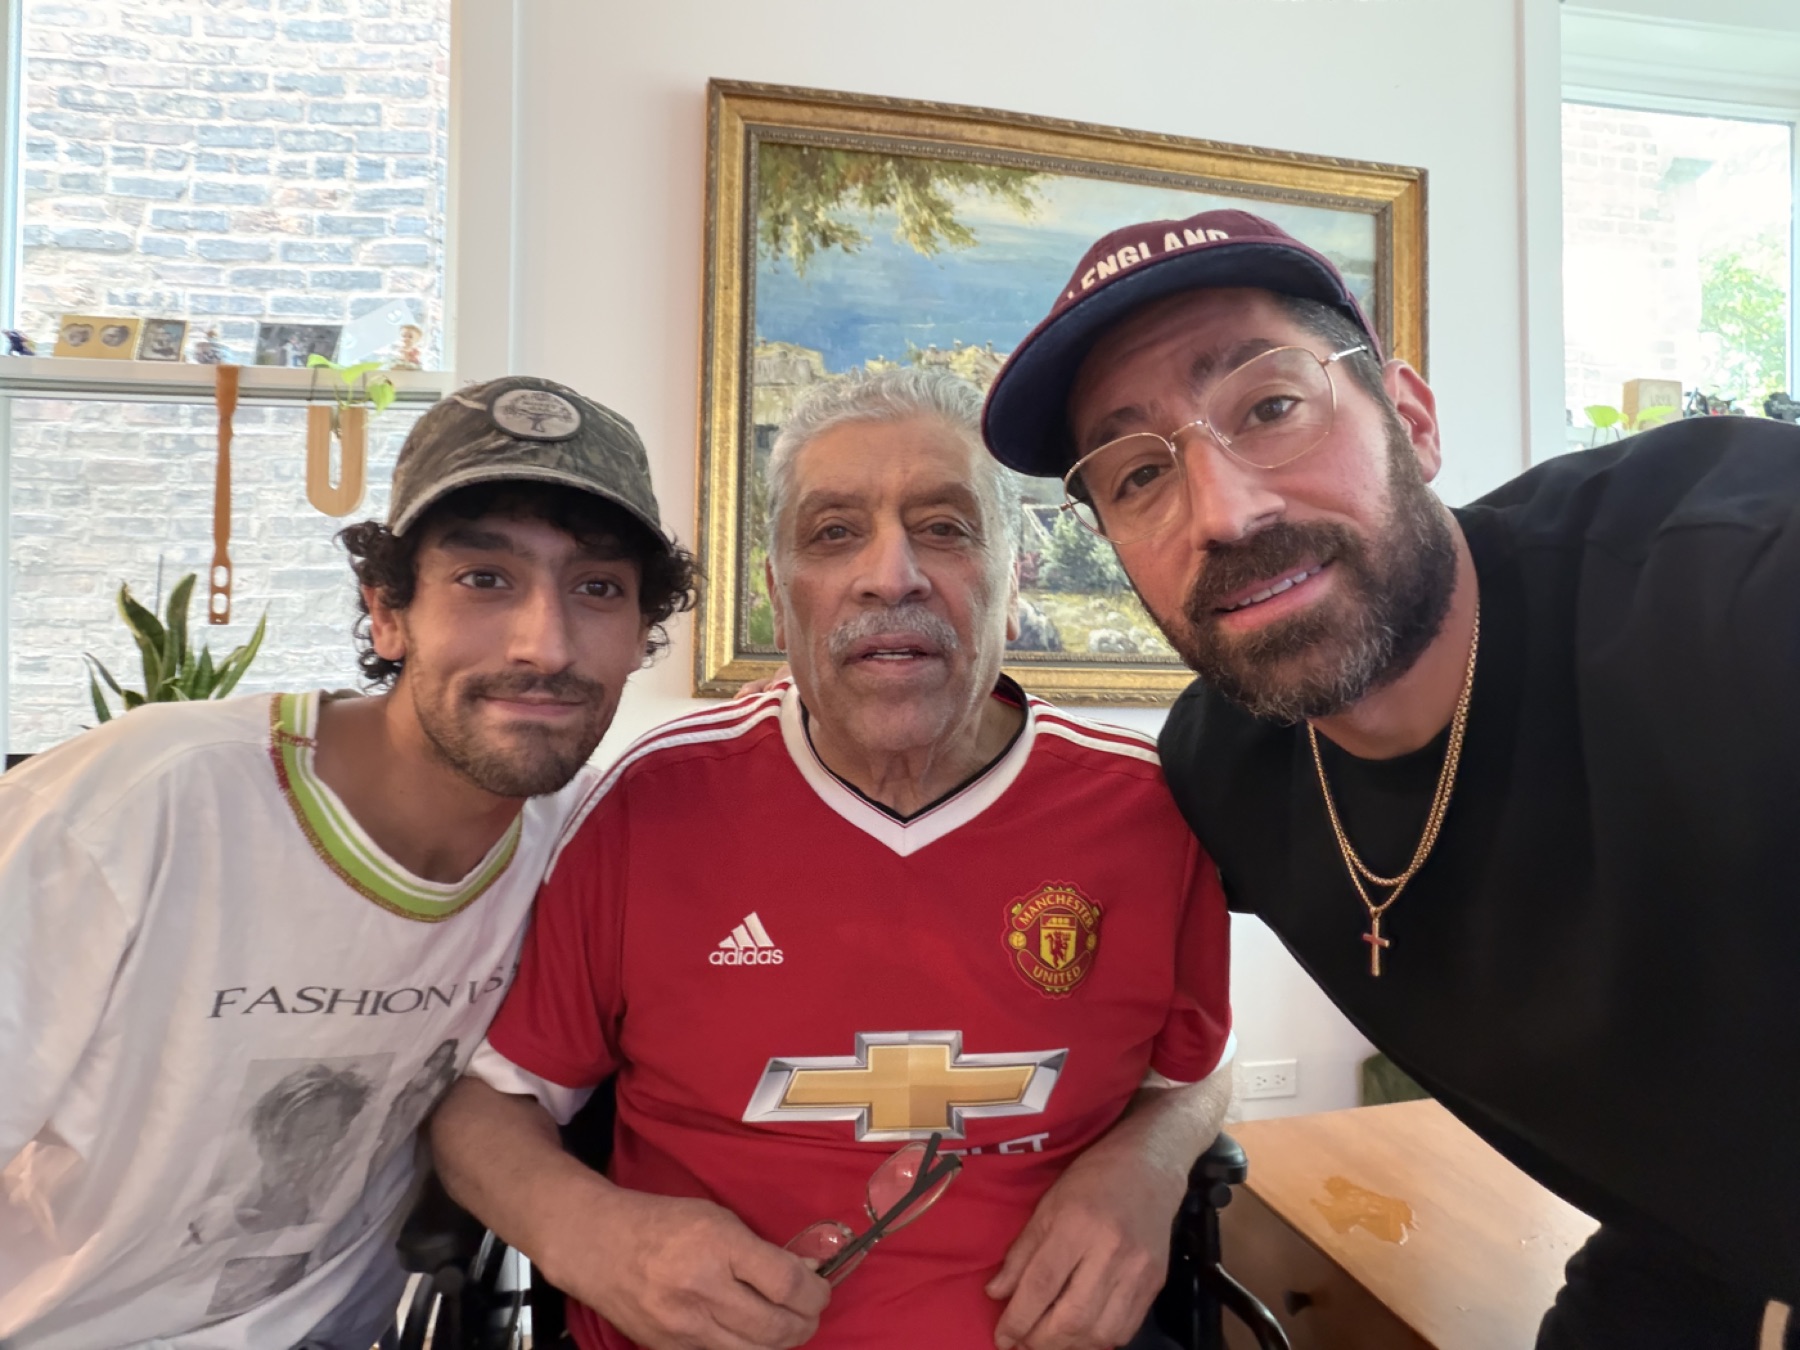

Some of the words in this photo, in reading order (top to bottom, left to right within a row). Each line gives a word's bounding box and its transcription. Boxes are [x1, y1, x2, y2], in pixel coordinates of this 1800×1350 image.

[1019, 894, 1094, 928] MANCHESTER
[708, 946, 784, 965] adidas
[1033, 966, 1081, 984] UNITED
[207, 985, 458, 1018] FASHION
